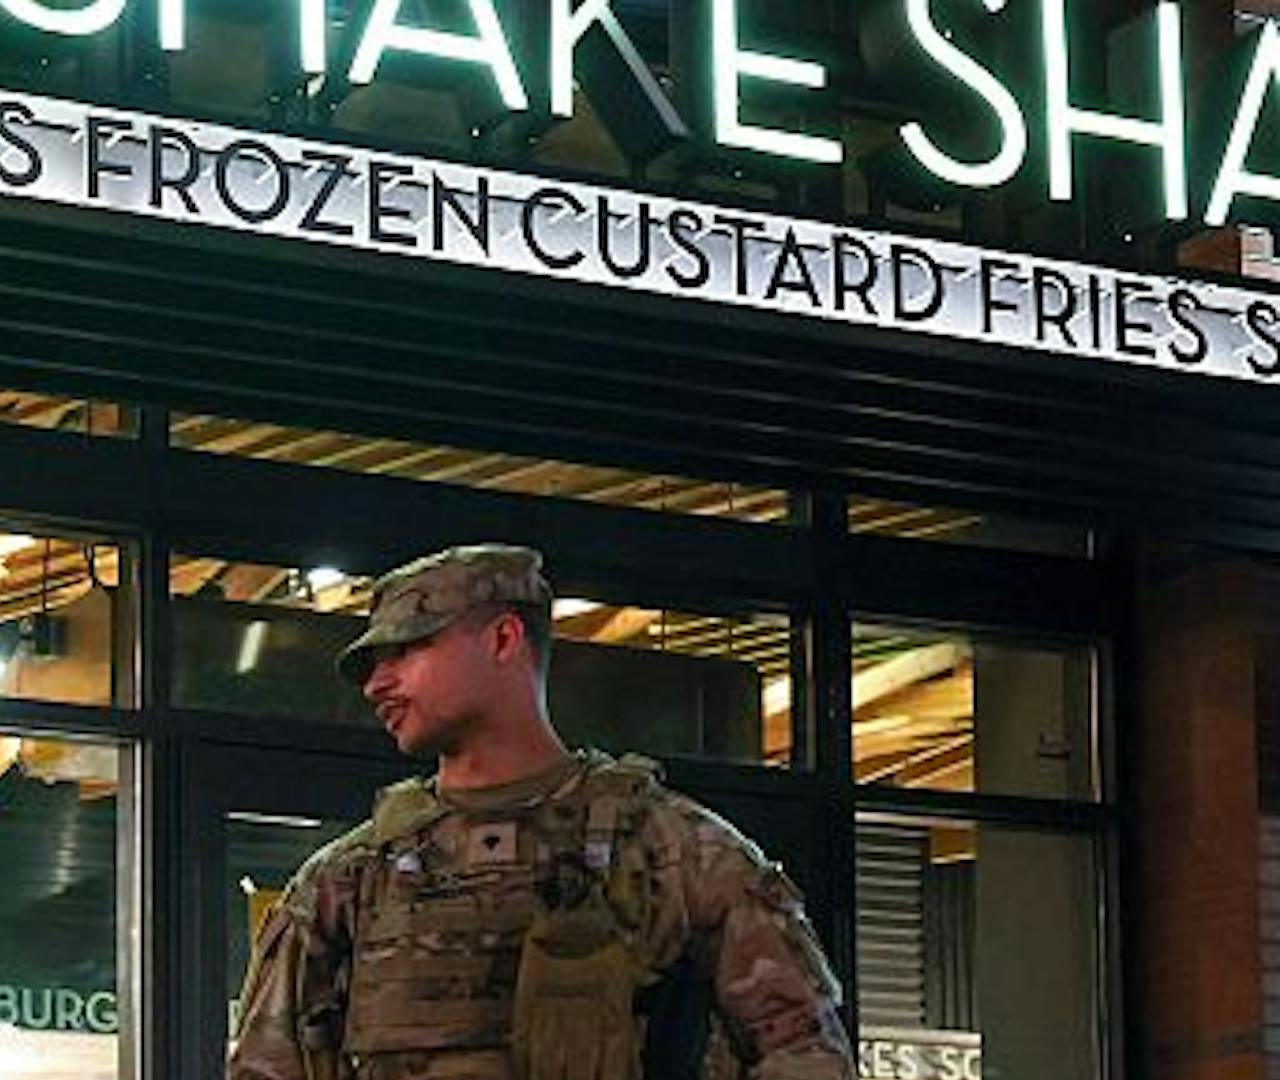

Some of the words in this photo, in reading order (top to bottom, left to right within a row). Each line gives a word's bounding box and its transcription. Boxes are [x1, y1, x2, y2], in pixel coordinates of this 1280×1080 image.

[87, 115, 491, 257] FROZEN
[522, 187, 944, 322] CUSTARD
[981, 260, 1208, 363] FRIES
